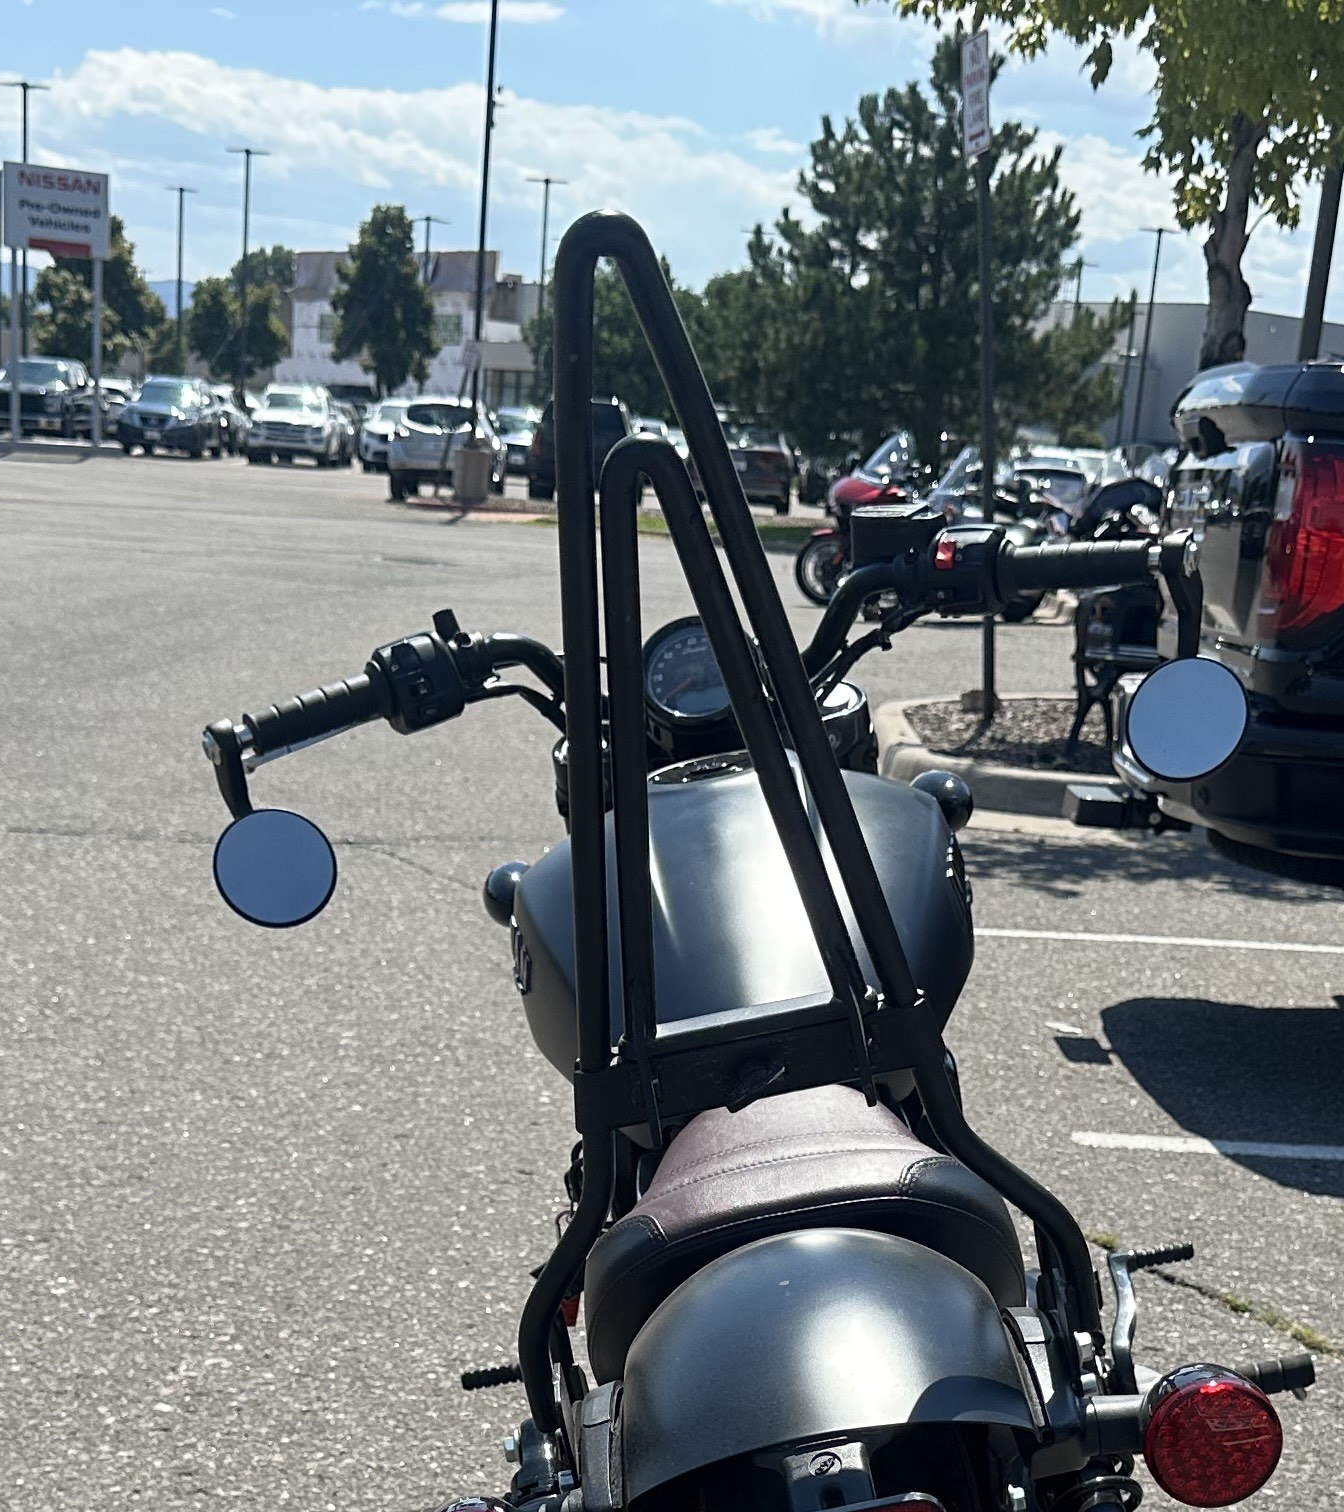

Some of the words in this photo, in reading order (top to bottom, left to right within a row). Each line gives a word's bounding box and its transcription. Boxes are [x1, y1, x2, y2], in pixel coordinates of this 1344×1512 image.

[18, 170, 101, 195] NISSAN
[18, 199, 101, 220] Pre-Owned
[27, 214, 91, 234] Vehicles
